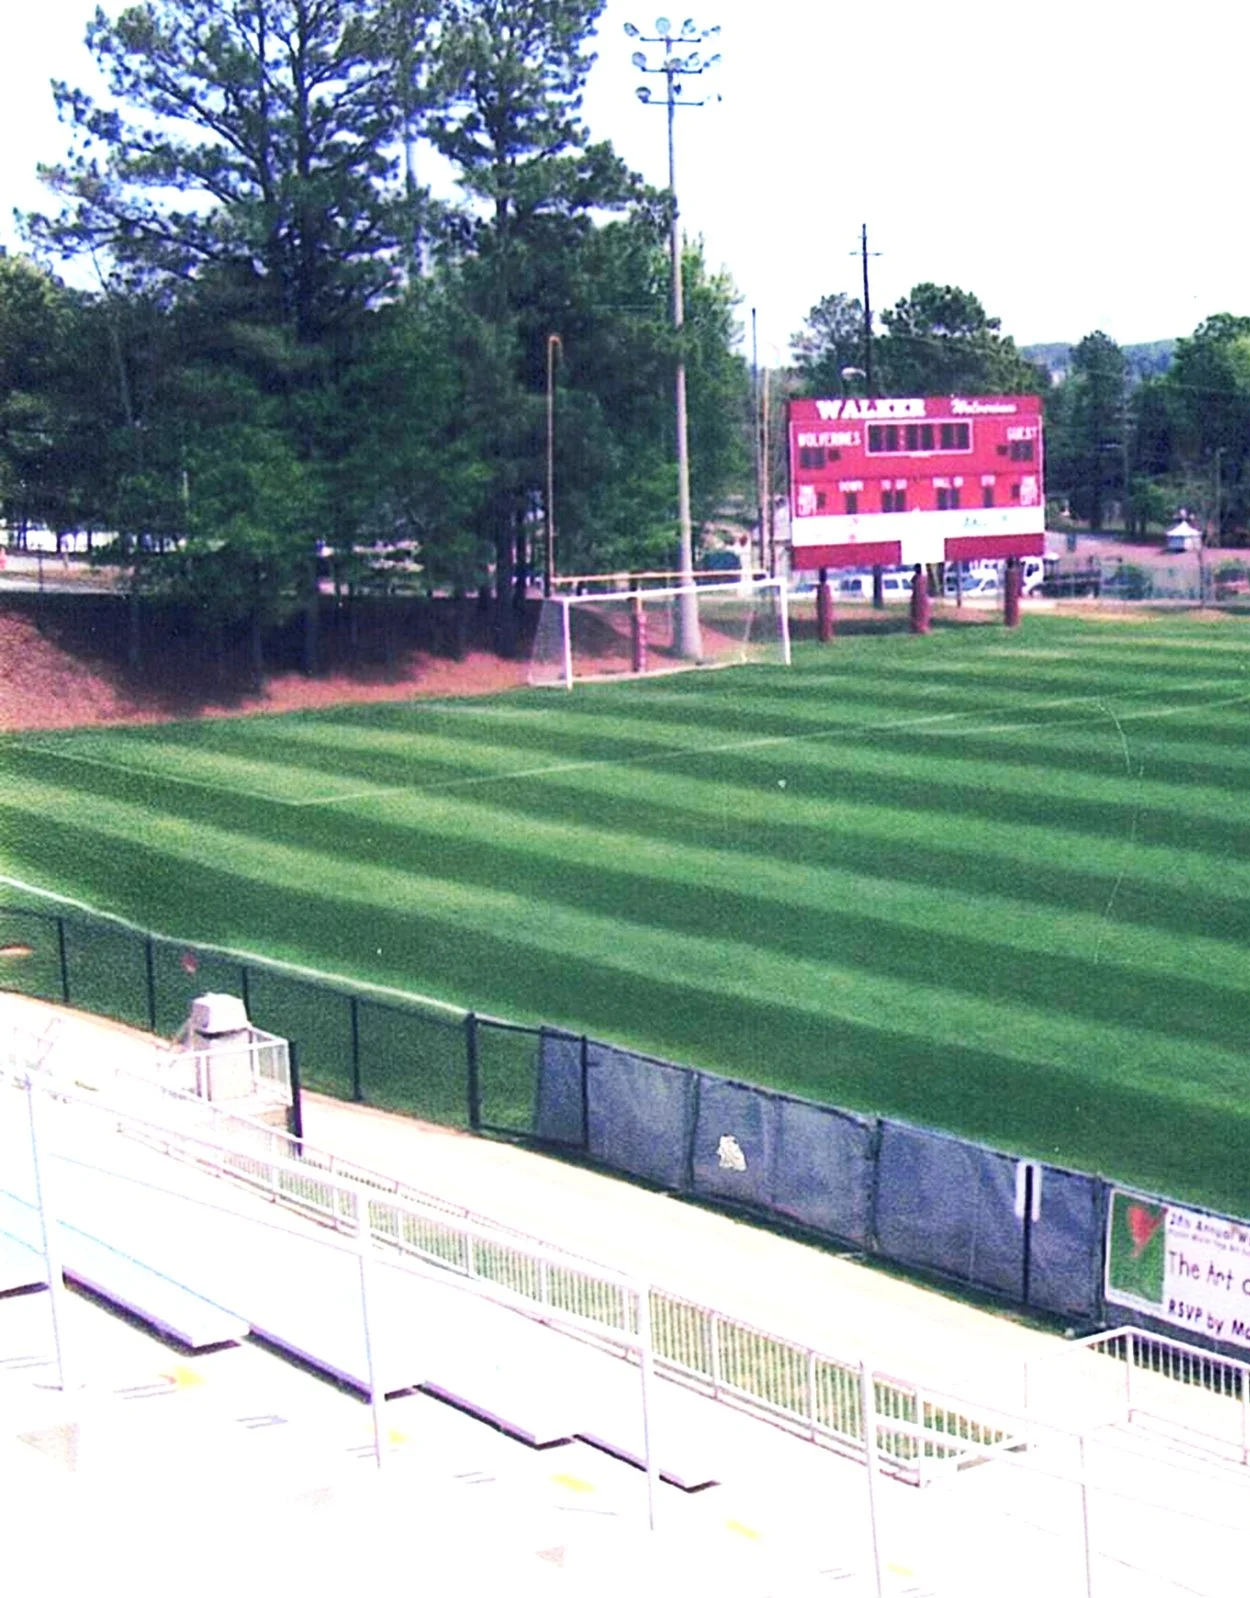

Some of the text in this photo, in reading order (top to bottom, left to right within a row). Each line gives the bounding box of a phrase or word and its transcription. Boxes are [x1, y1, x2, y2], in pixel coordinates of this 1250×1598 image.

[816, 398, 926, 420] WALKER
[797, 431, 861, 448] WOLVERINES
[1007, 426, 1038, 441] GUEST
[1196, 1219, 1233, 1240] Annual
[1169, 1251, 1200, 1280] The
[1207, 1262, 1233, 1291] Art
[1168, 1298, 1203, 1323] RSVP
[1206, 1311, 1225, 1335] by
